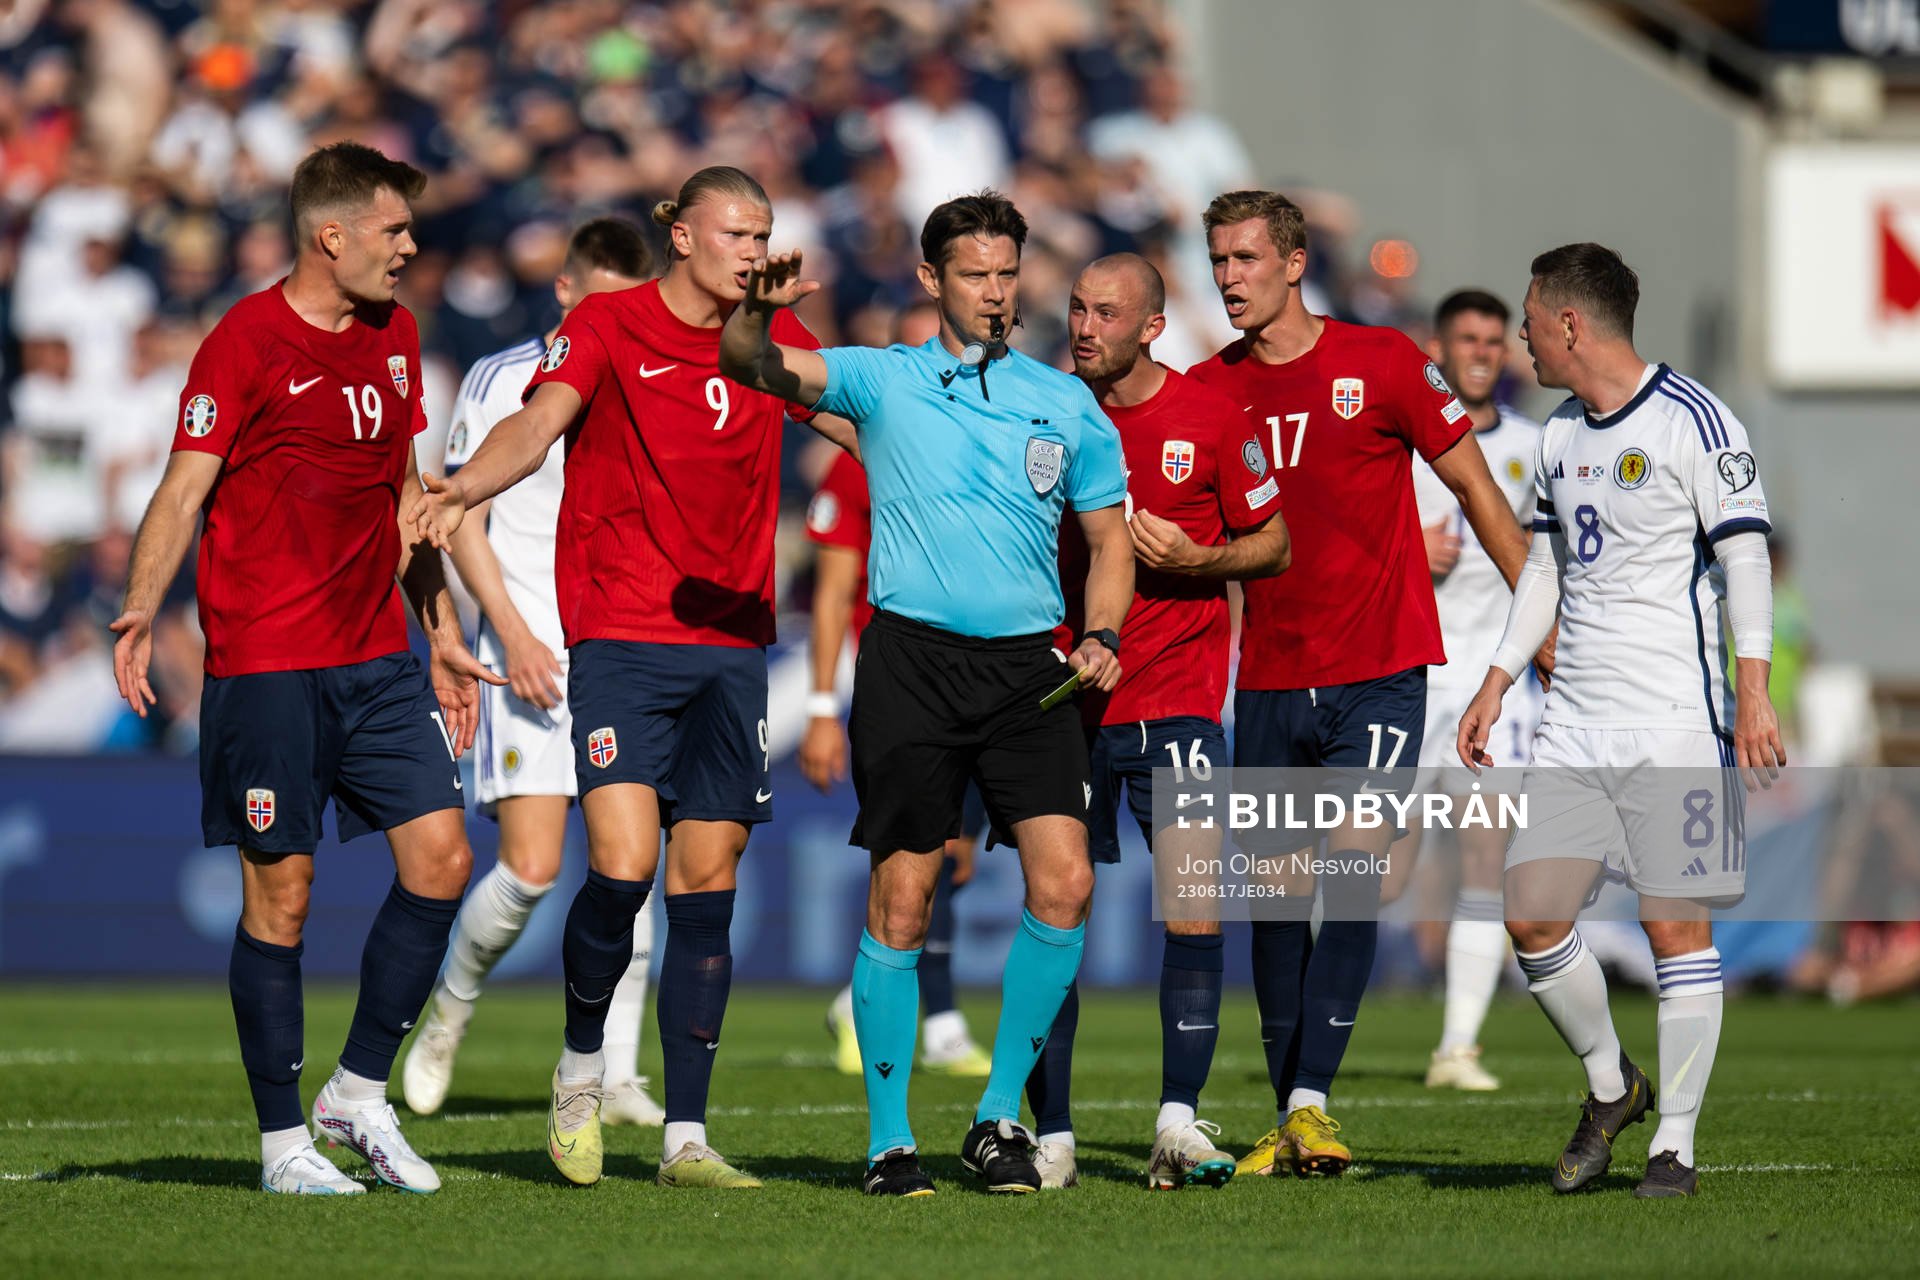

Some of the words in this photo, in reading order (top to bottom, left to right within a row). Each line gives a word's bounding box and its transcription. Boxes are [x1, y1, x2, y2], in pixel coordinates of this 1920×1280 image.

[341, 384, 383, 440] 19
[705, 377, 730, 431] 9
[1034, 461, 1054, 471] MATCH
[1265, 411, 1310, 470] 17
[1029, 468, 1054, 480] OFFICIAL
[1574, 504, 1604, 563] 8
[757, 718, 769, 772] 9
[1164, 738, 1213, 784] 16
[1367, 723, 1409, 775] 17
[1682, 788, 1715, 849] 8
